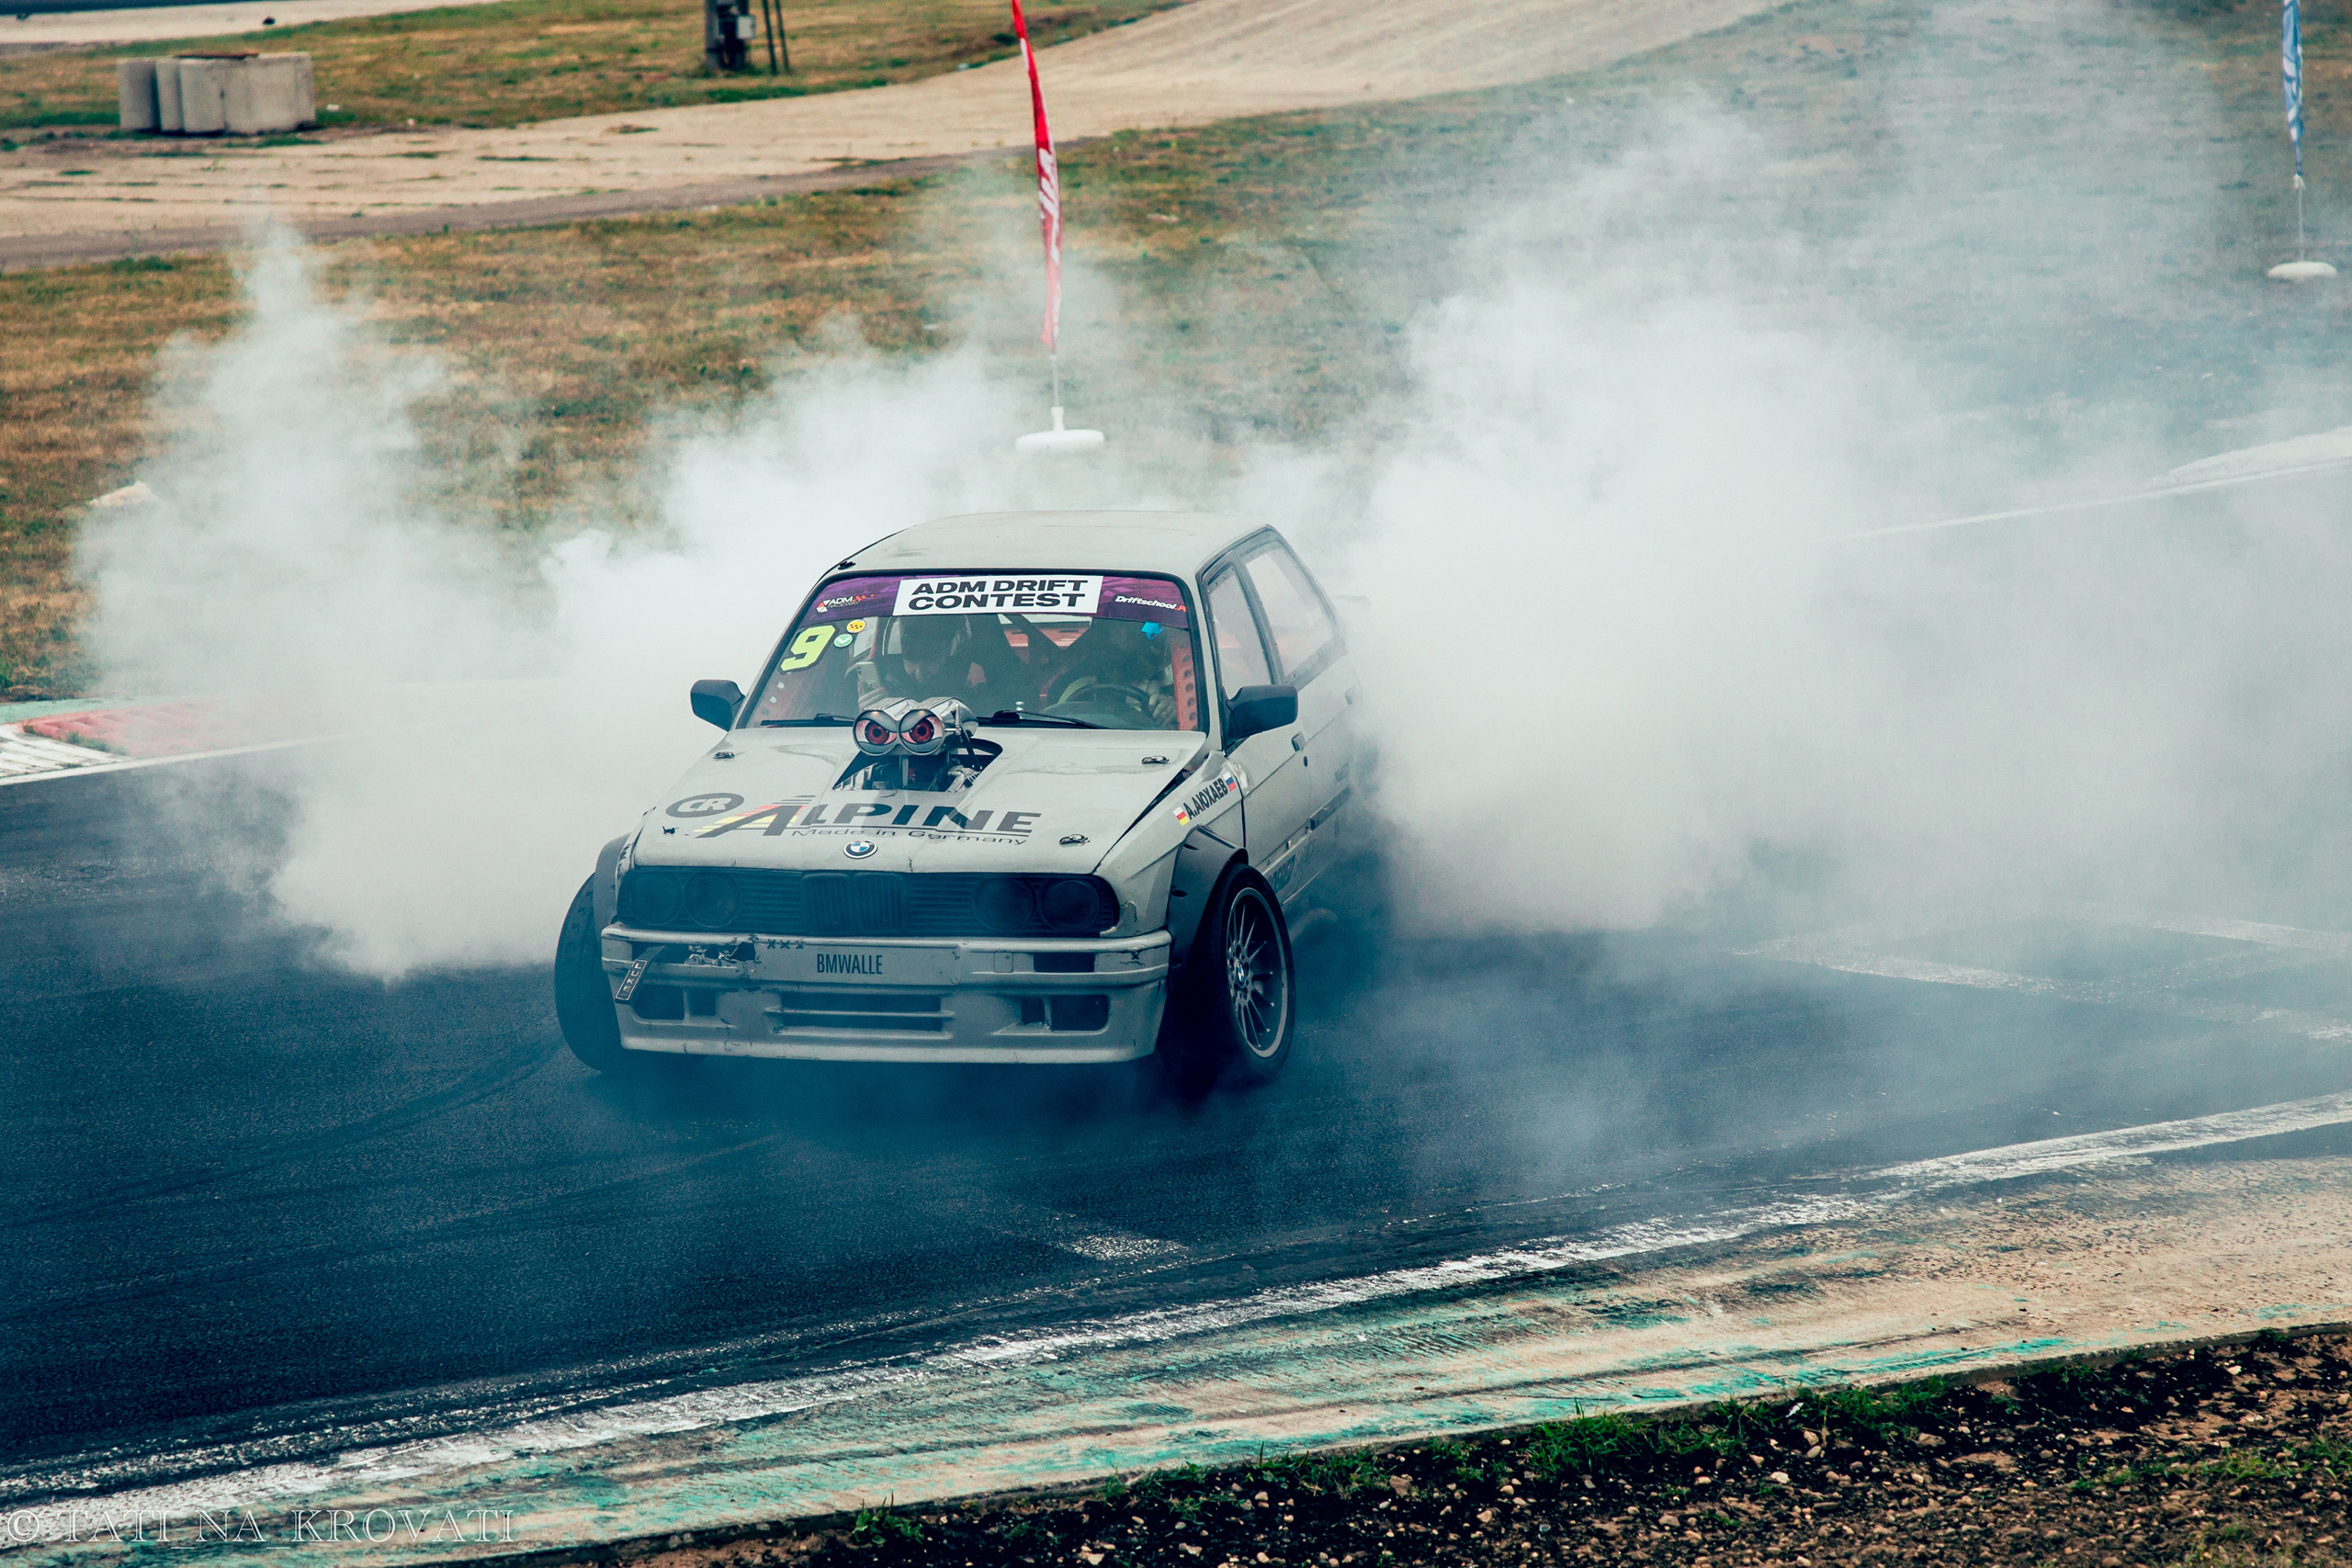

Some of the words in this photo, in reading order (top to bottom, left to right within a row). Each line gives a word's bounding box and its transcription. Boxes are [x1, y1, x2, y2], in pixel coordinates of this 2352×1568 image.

[911, 581, 987, 595] ADM
[992, 580, 1088, 592] DRIFT
[828, 596, 854, 605] ADM
[908, 592, 1085, 611] CONTEST
[780, 625, 836, 671] 9
[695, 803, 1043, 839] ALPINE
[791, 829, 865, 837] Made
[908, 830, 1027, 845] Germany
[817, 953, 883, 975] BMWALLE
[623, 963, 641, 992] LUKE
